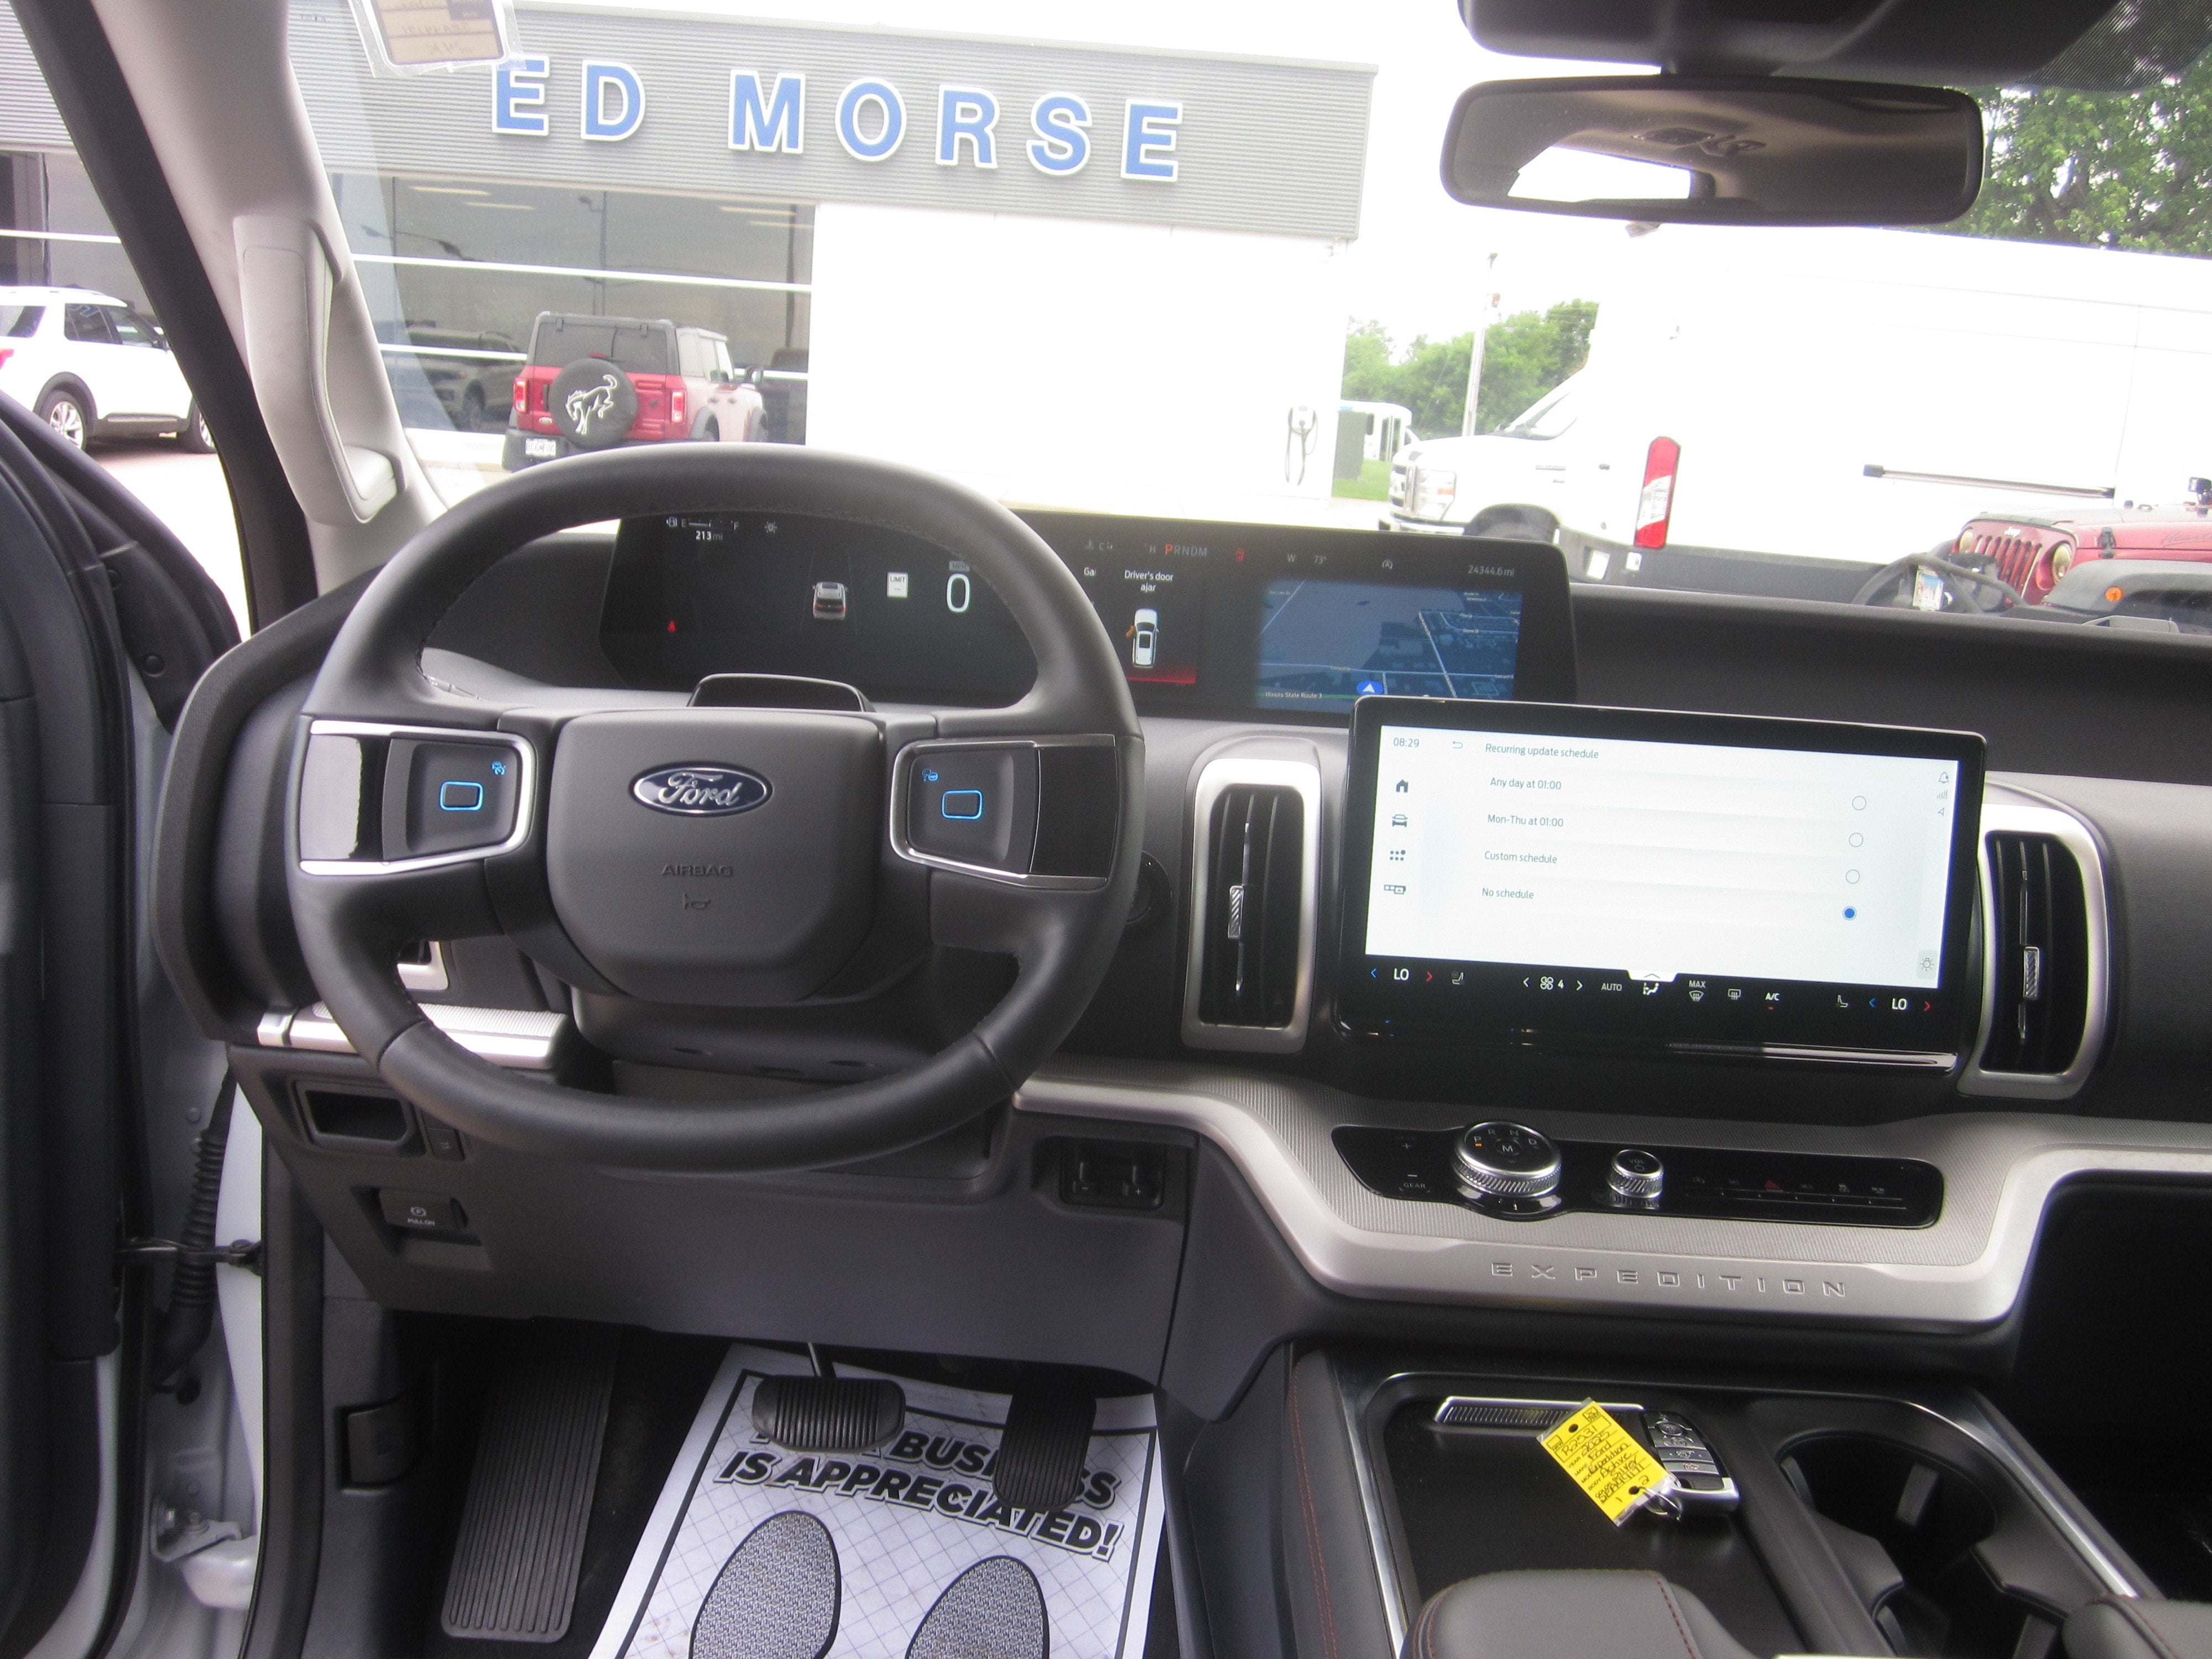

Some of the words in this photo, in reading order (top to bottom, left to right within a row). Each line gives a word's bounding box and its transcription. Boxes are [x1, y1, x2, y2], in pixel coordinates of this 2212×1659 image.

[492, 54, 646, 140] ED
[728, 69, 1183, 182] MORSE
[695, 530, 712, 540] 213
[712, 532, 723, 541] mi
[1287, 553, 1296, 562] W
[1124, 570, 1154, 580] Driver's
[1155, 571, 1174, 581] door
[1468, 565, 1503, 576] 24344.6
[1504, 567, 1515, 576] mi
[946, 573, 971, 613] 0
[1140, 582, 1156, 593] ajar
[1393, 738, 1420, 748] 08:29
[1485, 743, 1526, 756] Recurring
[1527, 747, 1558, 759] update
[1561, 749, 1599, 759] schedule
[658, 771, 743, 806] Ford
[1490, 778, 1506, 789] Any
[1509, 779, 1525, 789] day
[1537, 780, 1562, 790] 01:00
[1488, 814, 1526, 825] Mon-Thu
[1529, 817, 1537, 826] at
[1540, 817, 1563, 827] 01:00
[1484, 851, 1517, 862] Custom
[1519, 853, 1558, 864] schedule
[661, 864, 733, 877] AIRBAG
[1482, 888, 1494, 897] No
[1496, 889, 1534, 900] schedule
[1394, 969, 1409, 980] LO
[1558, 979, 1564, 988] 4
[1601, 983, 1623, 992] AUTO
[1765, 993, 1780, 1001] A/C
[1892, 999, 1907, 1010] LO
[1491, 1262, 1846, 1297] EXPEDITION
[1552, 1440, 1563, 1452] NEW
[1567, 1457, 1581, 1469] YEAR
[1582, 1430, 1610, 1457] 2025
[1588, 1441, 1613, 1460] Ford
[1588, 1477, 1601, 1490] BODY
[714, 1451, 781, 1484] IS
[769, 1455, 1124, 1562] APPRECIATED!
